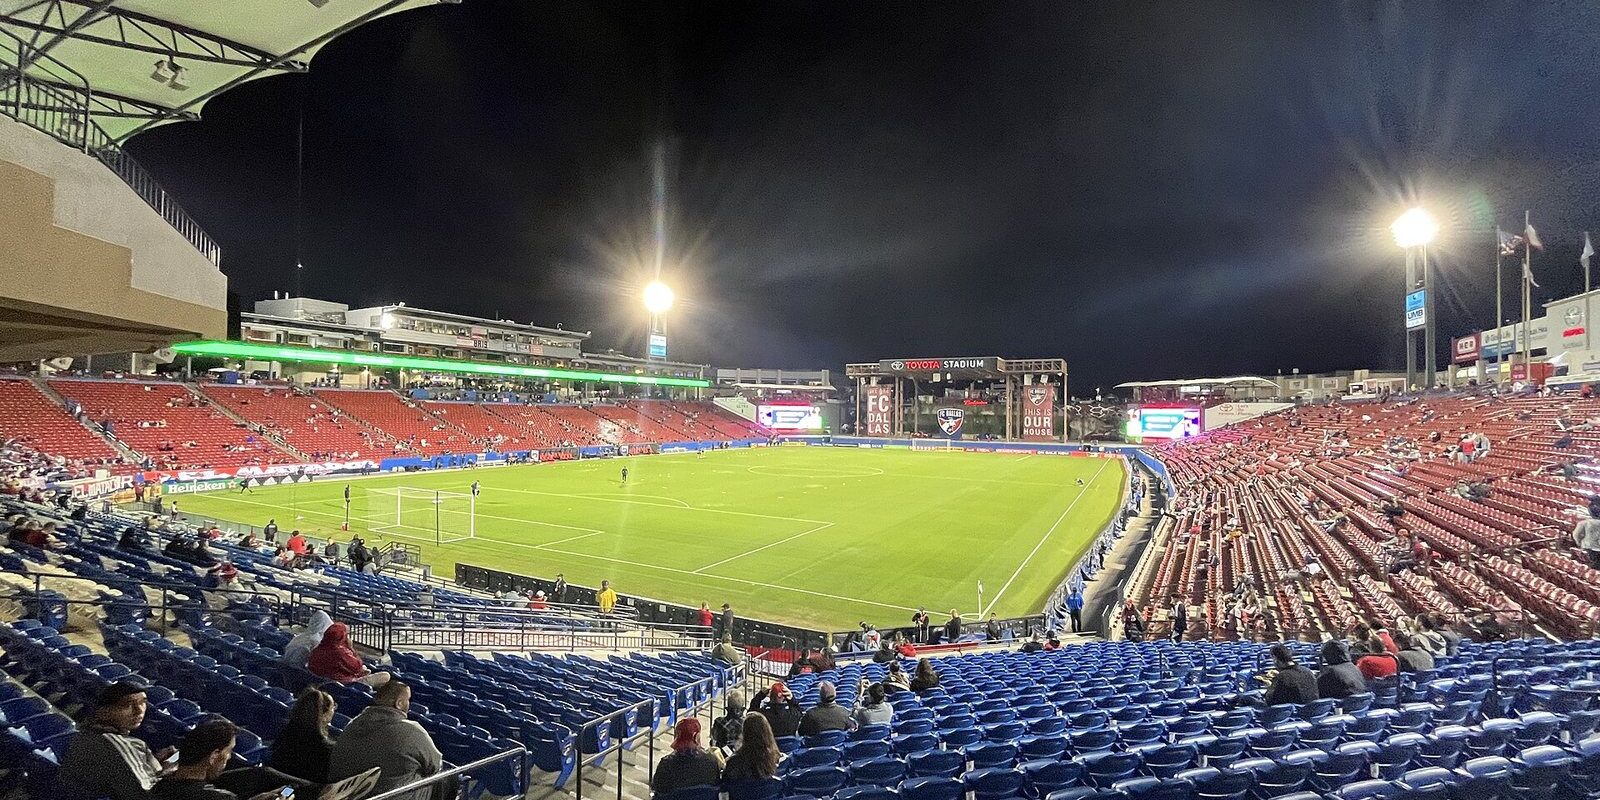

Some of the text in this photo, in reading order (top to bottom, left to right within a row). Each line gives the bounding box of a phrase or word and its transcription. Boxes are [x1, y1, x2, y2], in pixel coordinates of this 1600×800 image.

[905, 359, 984, 369] TOYOTA STADIUM
[868, 394, 889, 412] FC
[868, 412, 889, 423] DAL
[1024, 408, 1052, 416] THIS IS
[1024, 416, 1051, 428] OUR
[868, 423, 889, 434] LAS
[1023, 428, 1052, 436] HOUSE
[168, 481, 226, 494] Heineken
